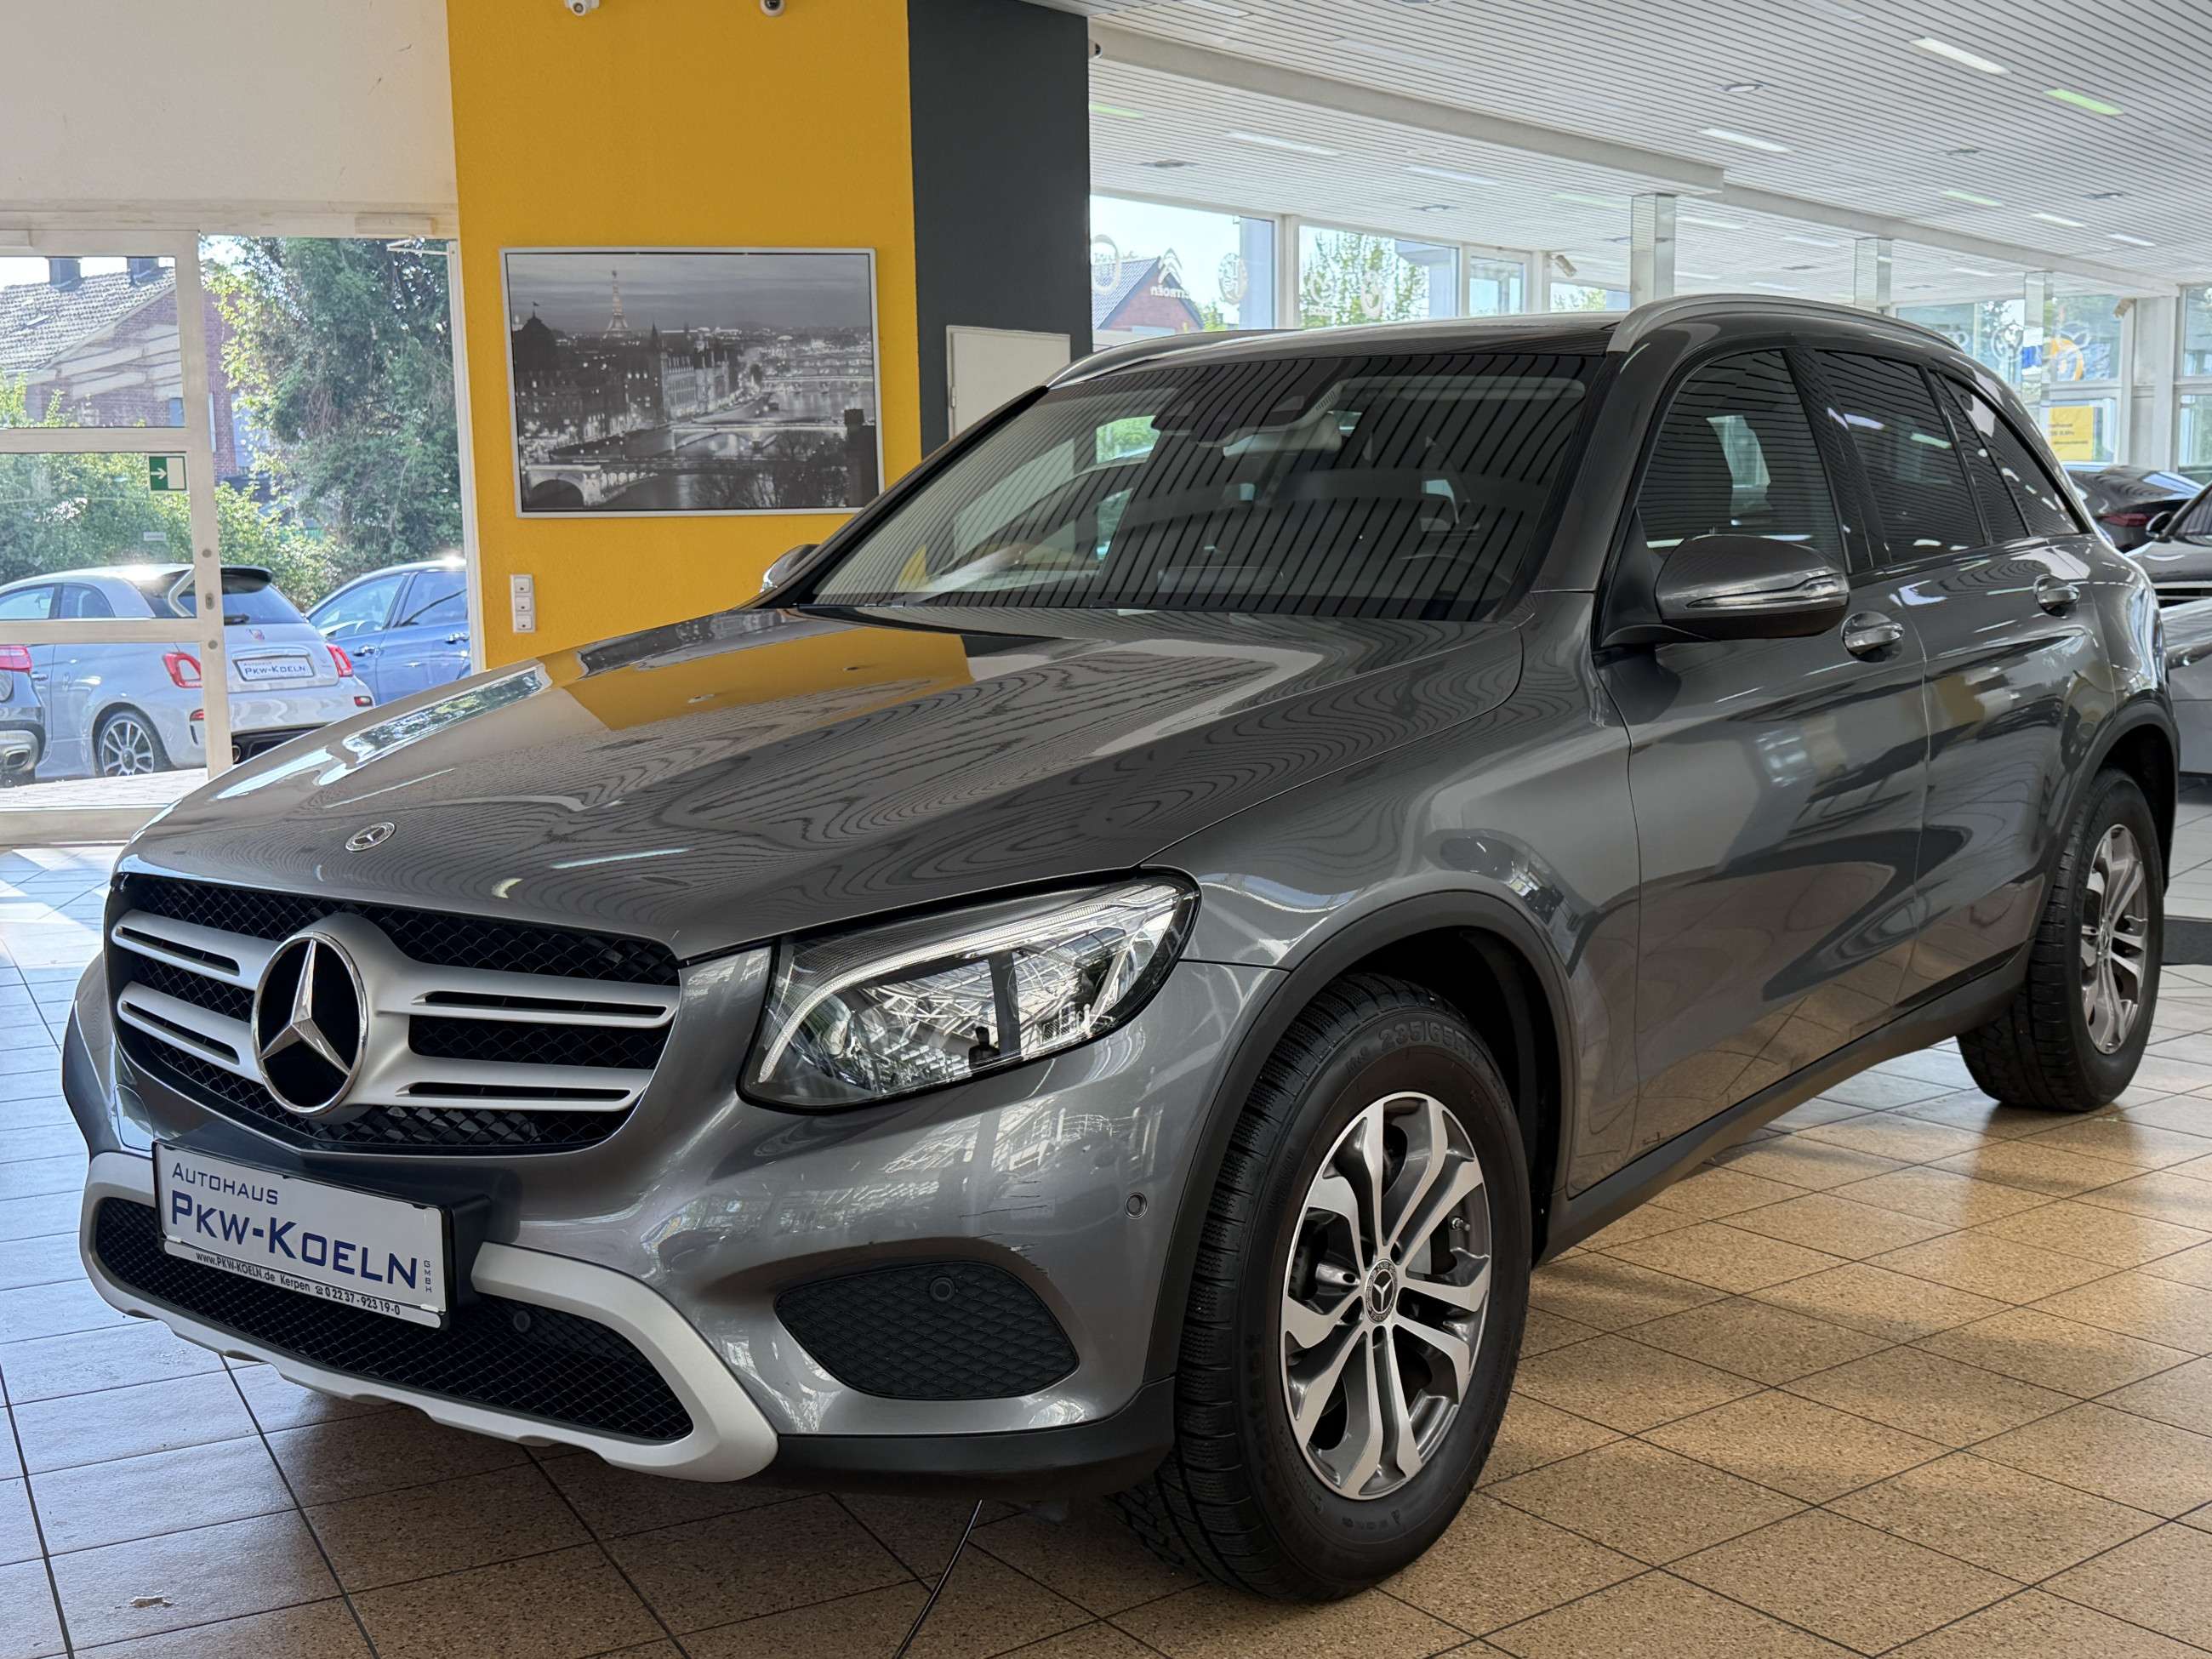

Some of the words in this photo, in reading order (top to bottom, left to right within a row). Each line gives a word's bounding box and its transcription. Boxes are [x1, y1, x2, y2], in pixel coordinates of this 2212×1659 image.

[172, 1162, 279, 1205] AUTOHAUS
[171, 1189, 418, 1289] PKW-KOELN
[196, 1251, 276, 1282] www.PKW-KOELN.de
[280, 1274, 311, 1292] Kerpen
[424, 1259, 433, 1294] GMBH
